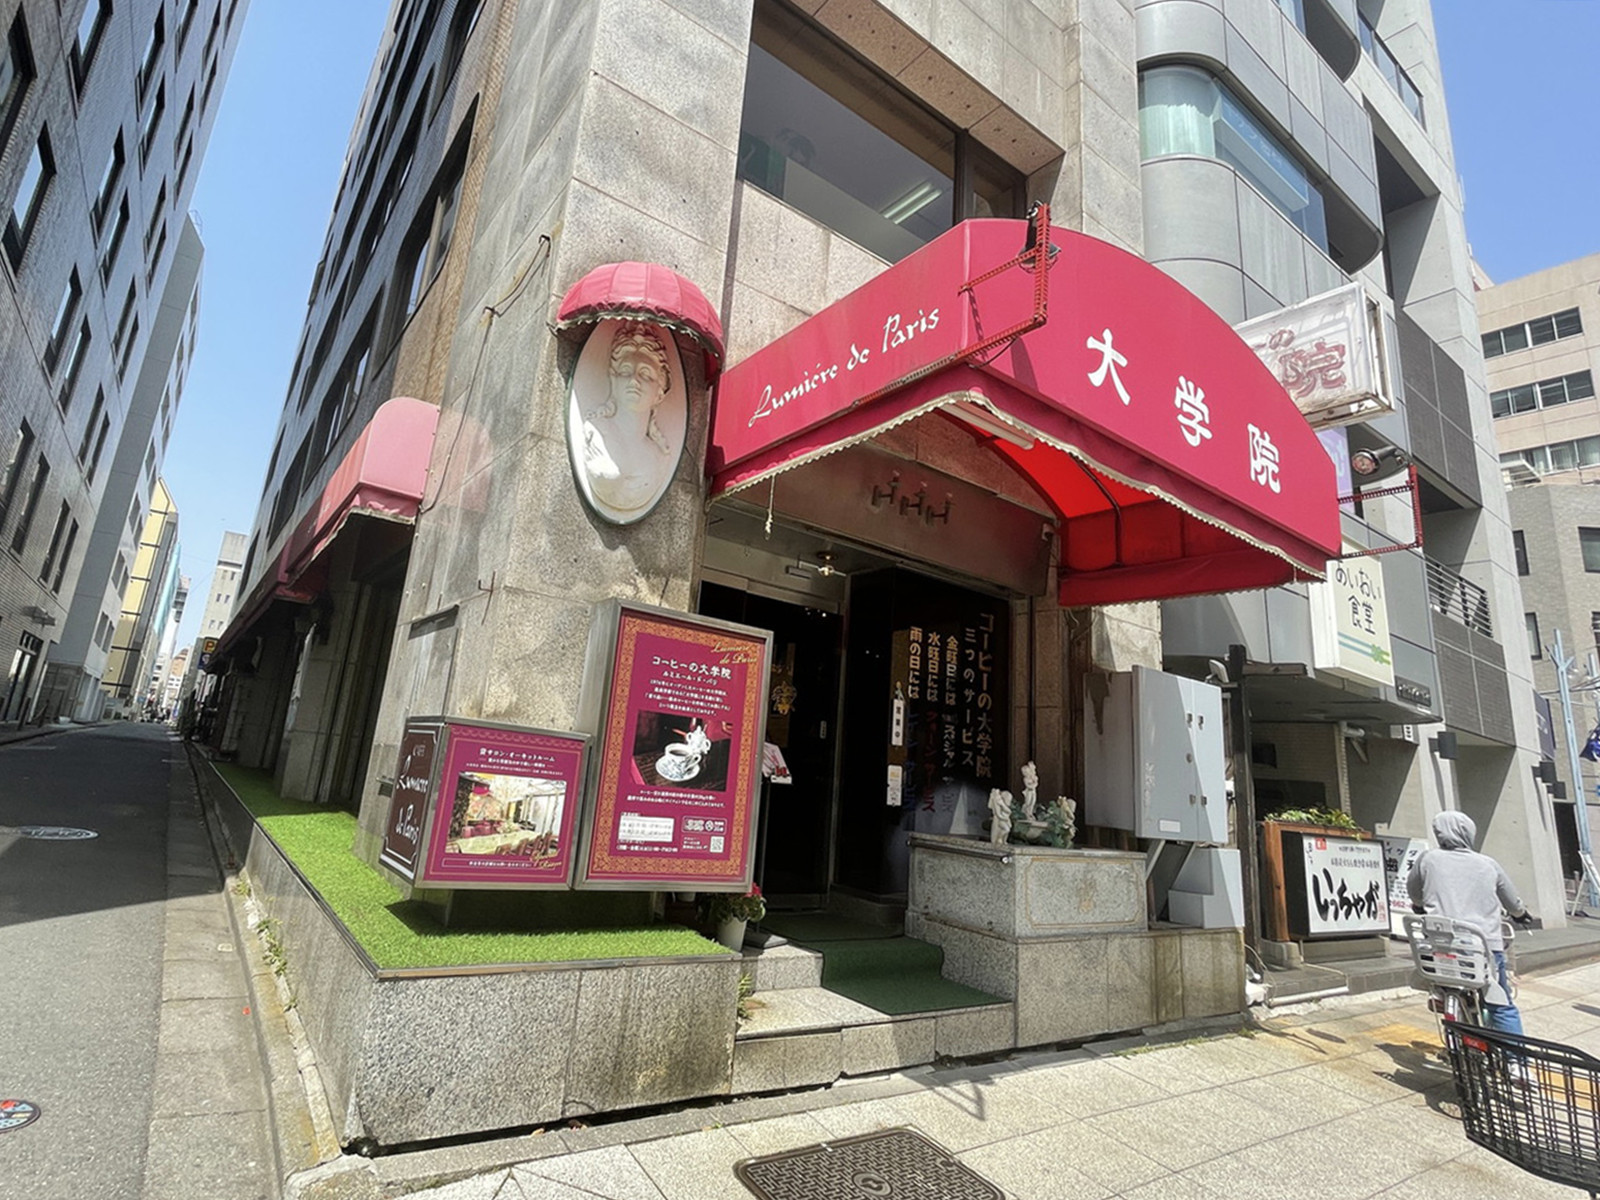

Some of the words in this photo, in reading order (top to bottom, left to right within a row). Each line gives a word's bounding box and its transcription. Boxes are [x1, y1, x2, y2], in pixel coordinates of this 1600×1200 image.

[847, 343, 870, 371] de
[881, 308, 940, 353] Paris
[1086, 328, 1281, 494] 大学院
[1348, 595, 1376, 635] 食堂
[652, 656, 731, 679] コーヒーの大学院
[908, 626, 922, 699] 雨の日には
[961, 628, 977, 767] 三つのサービス
[976, 613, 994, 778] コーヒーの大学院
